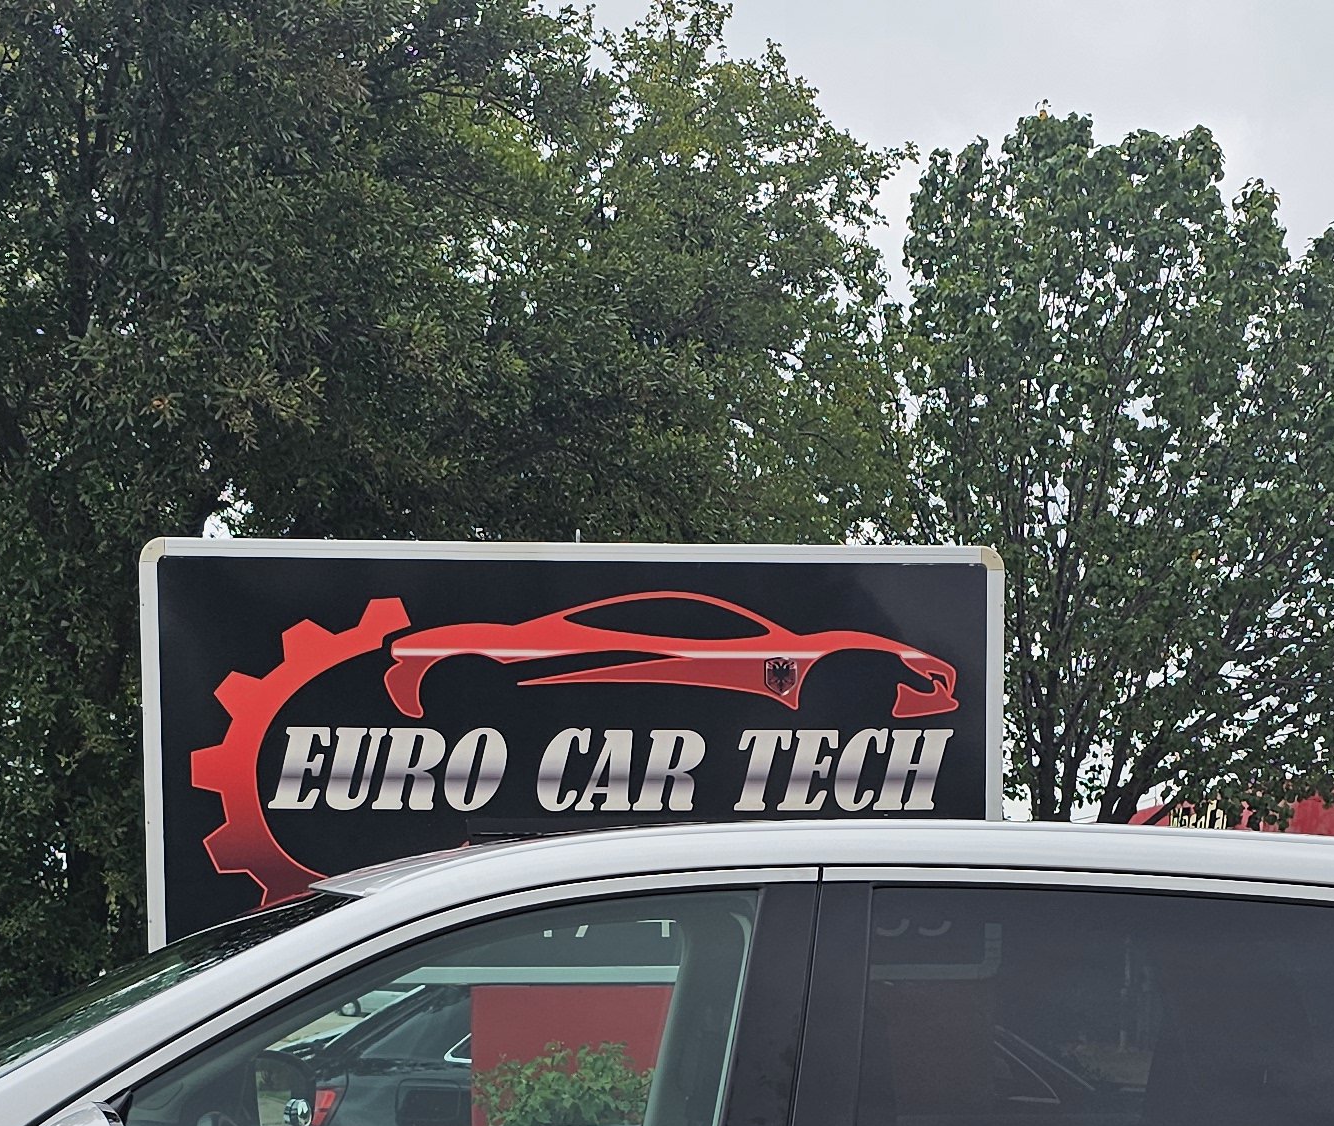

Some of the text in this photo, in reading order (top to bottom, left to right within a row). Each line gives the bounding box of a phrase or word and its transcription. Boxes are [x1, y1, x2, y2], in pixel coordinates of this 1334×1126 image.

[267, 726, 955, 812] EURO CAR TECH
